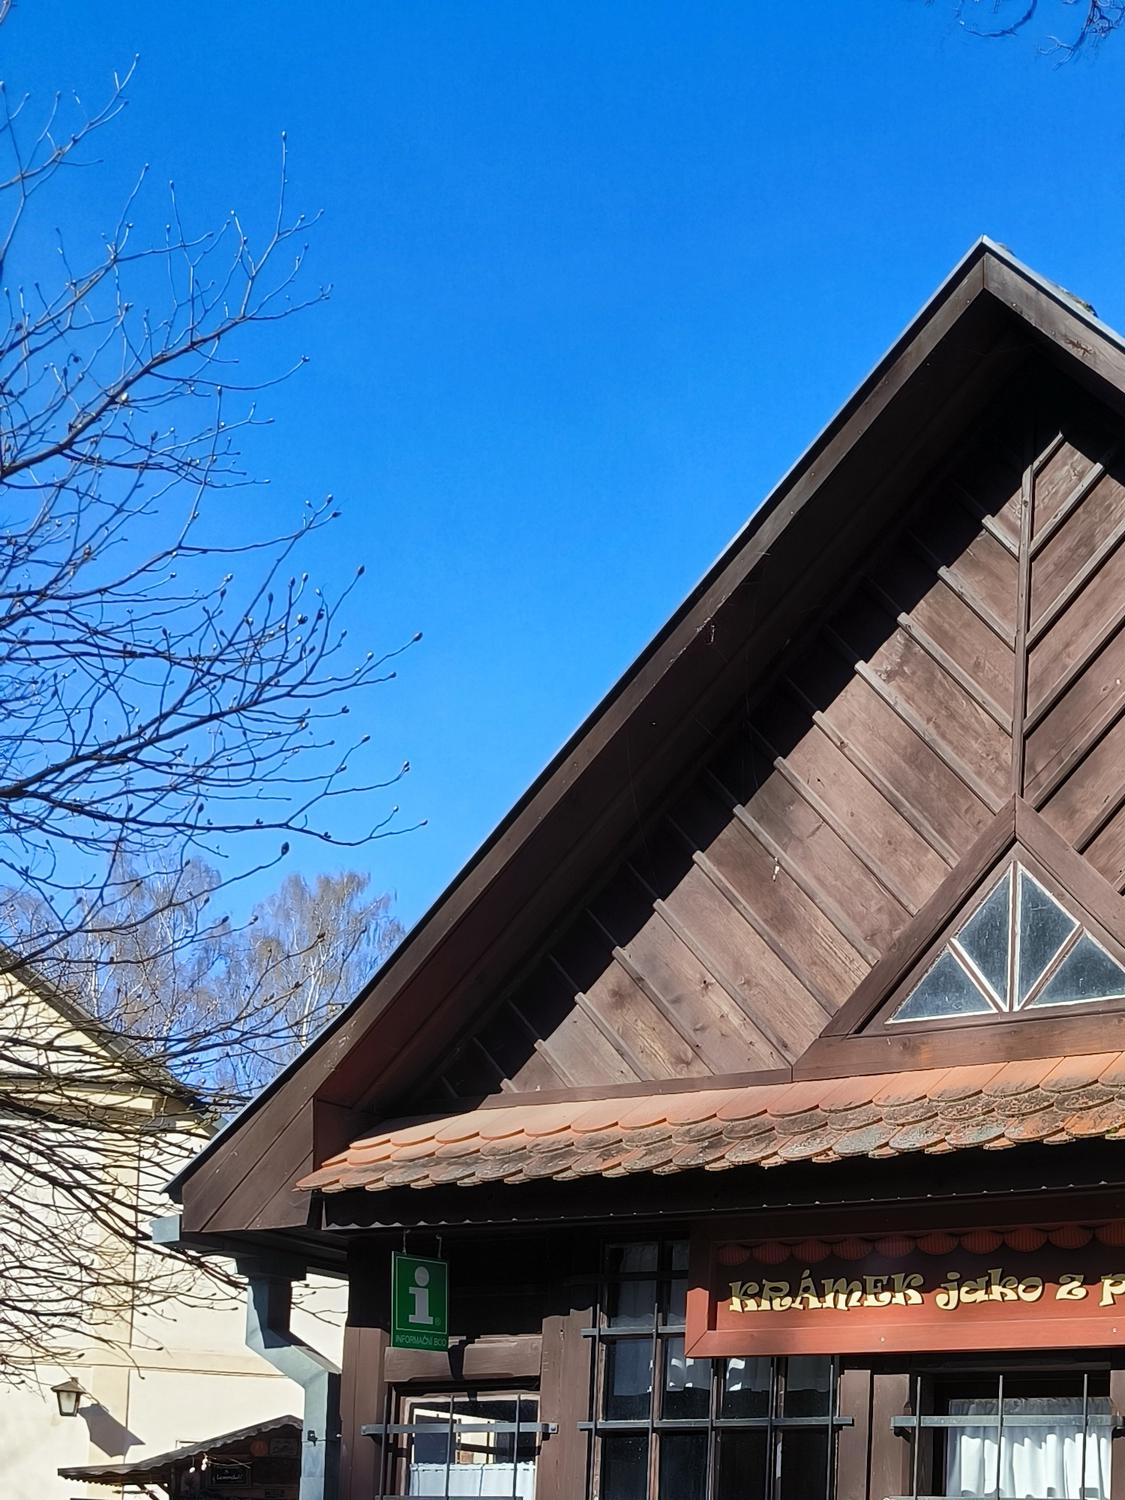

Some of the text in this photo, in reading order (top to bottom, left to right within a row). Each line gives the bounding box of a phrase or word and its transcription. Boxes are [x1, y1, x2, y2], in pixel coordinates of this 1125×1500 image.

[729, 1269, 924, 1312] KRÁMEK
[935, 1267, 1043, 1311] jako
[1055, 1274, 1086, 1301] z
